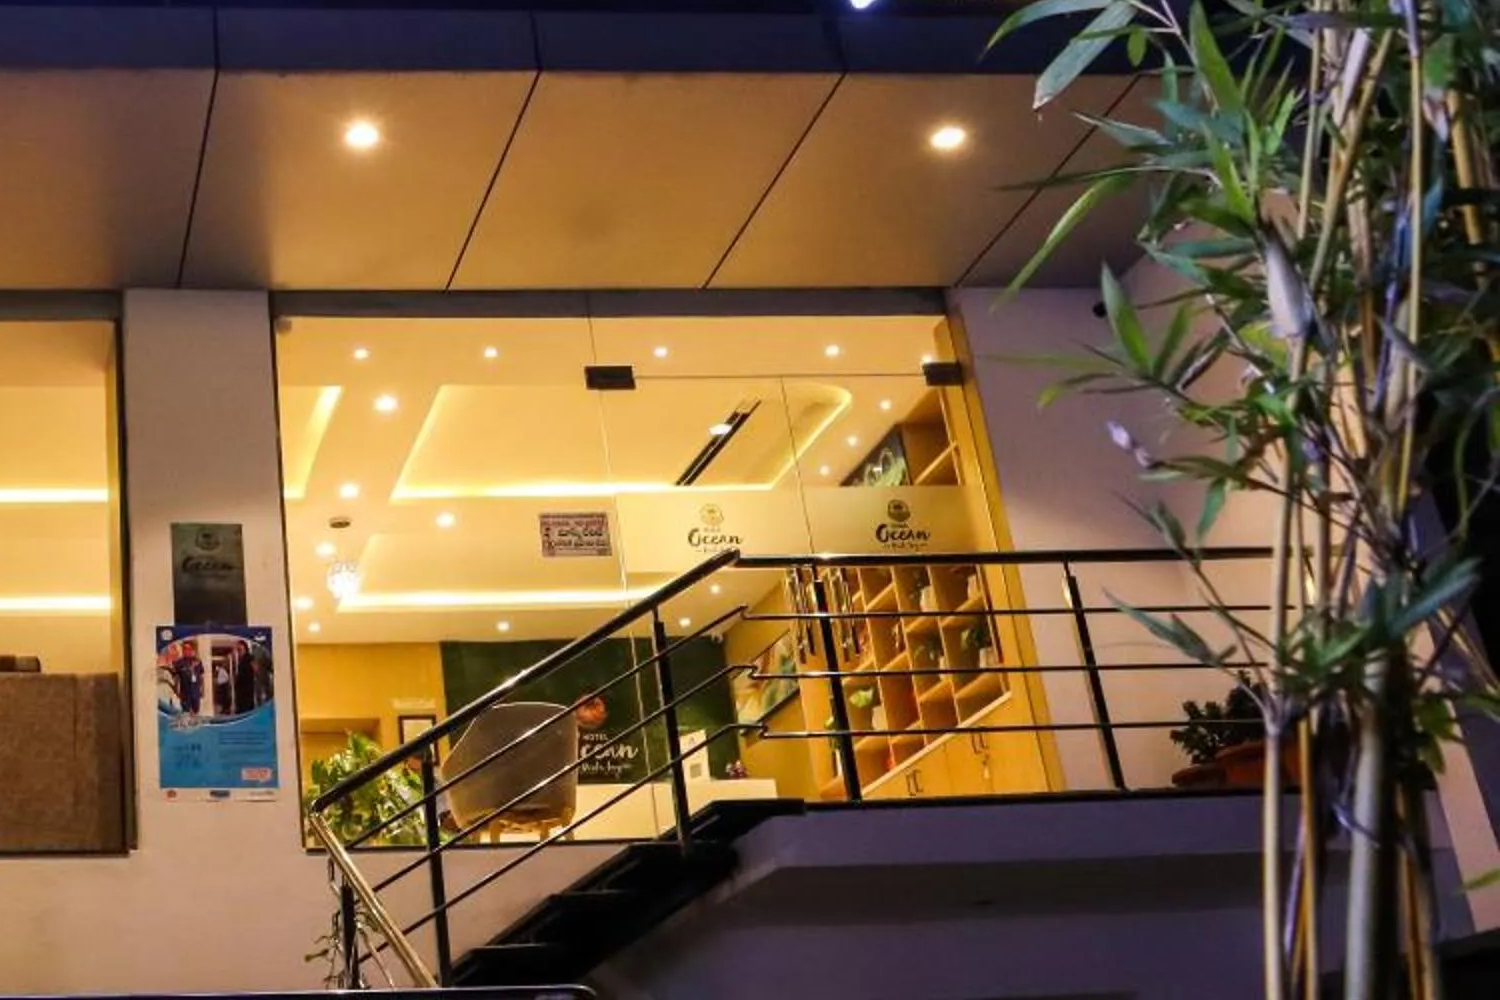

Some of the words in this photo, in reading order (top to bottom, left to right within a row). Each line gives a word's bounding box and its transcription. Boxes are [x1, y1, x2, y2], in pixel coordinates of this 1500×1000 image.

[688, 527, 743, 547] Ocean
[876, 523, 931, 543] Ocean
[580, 743, 639, 759] cean
